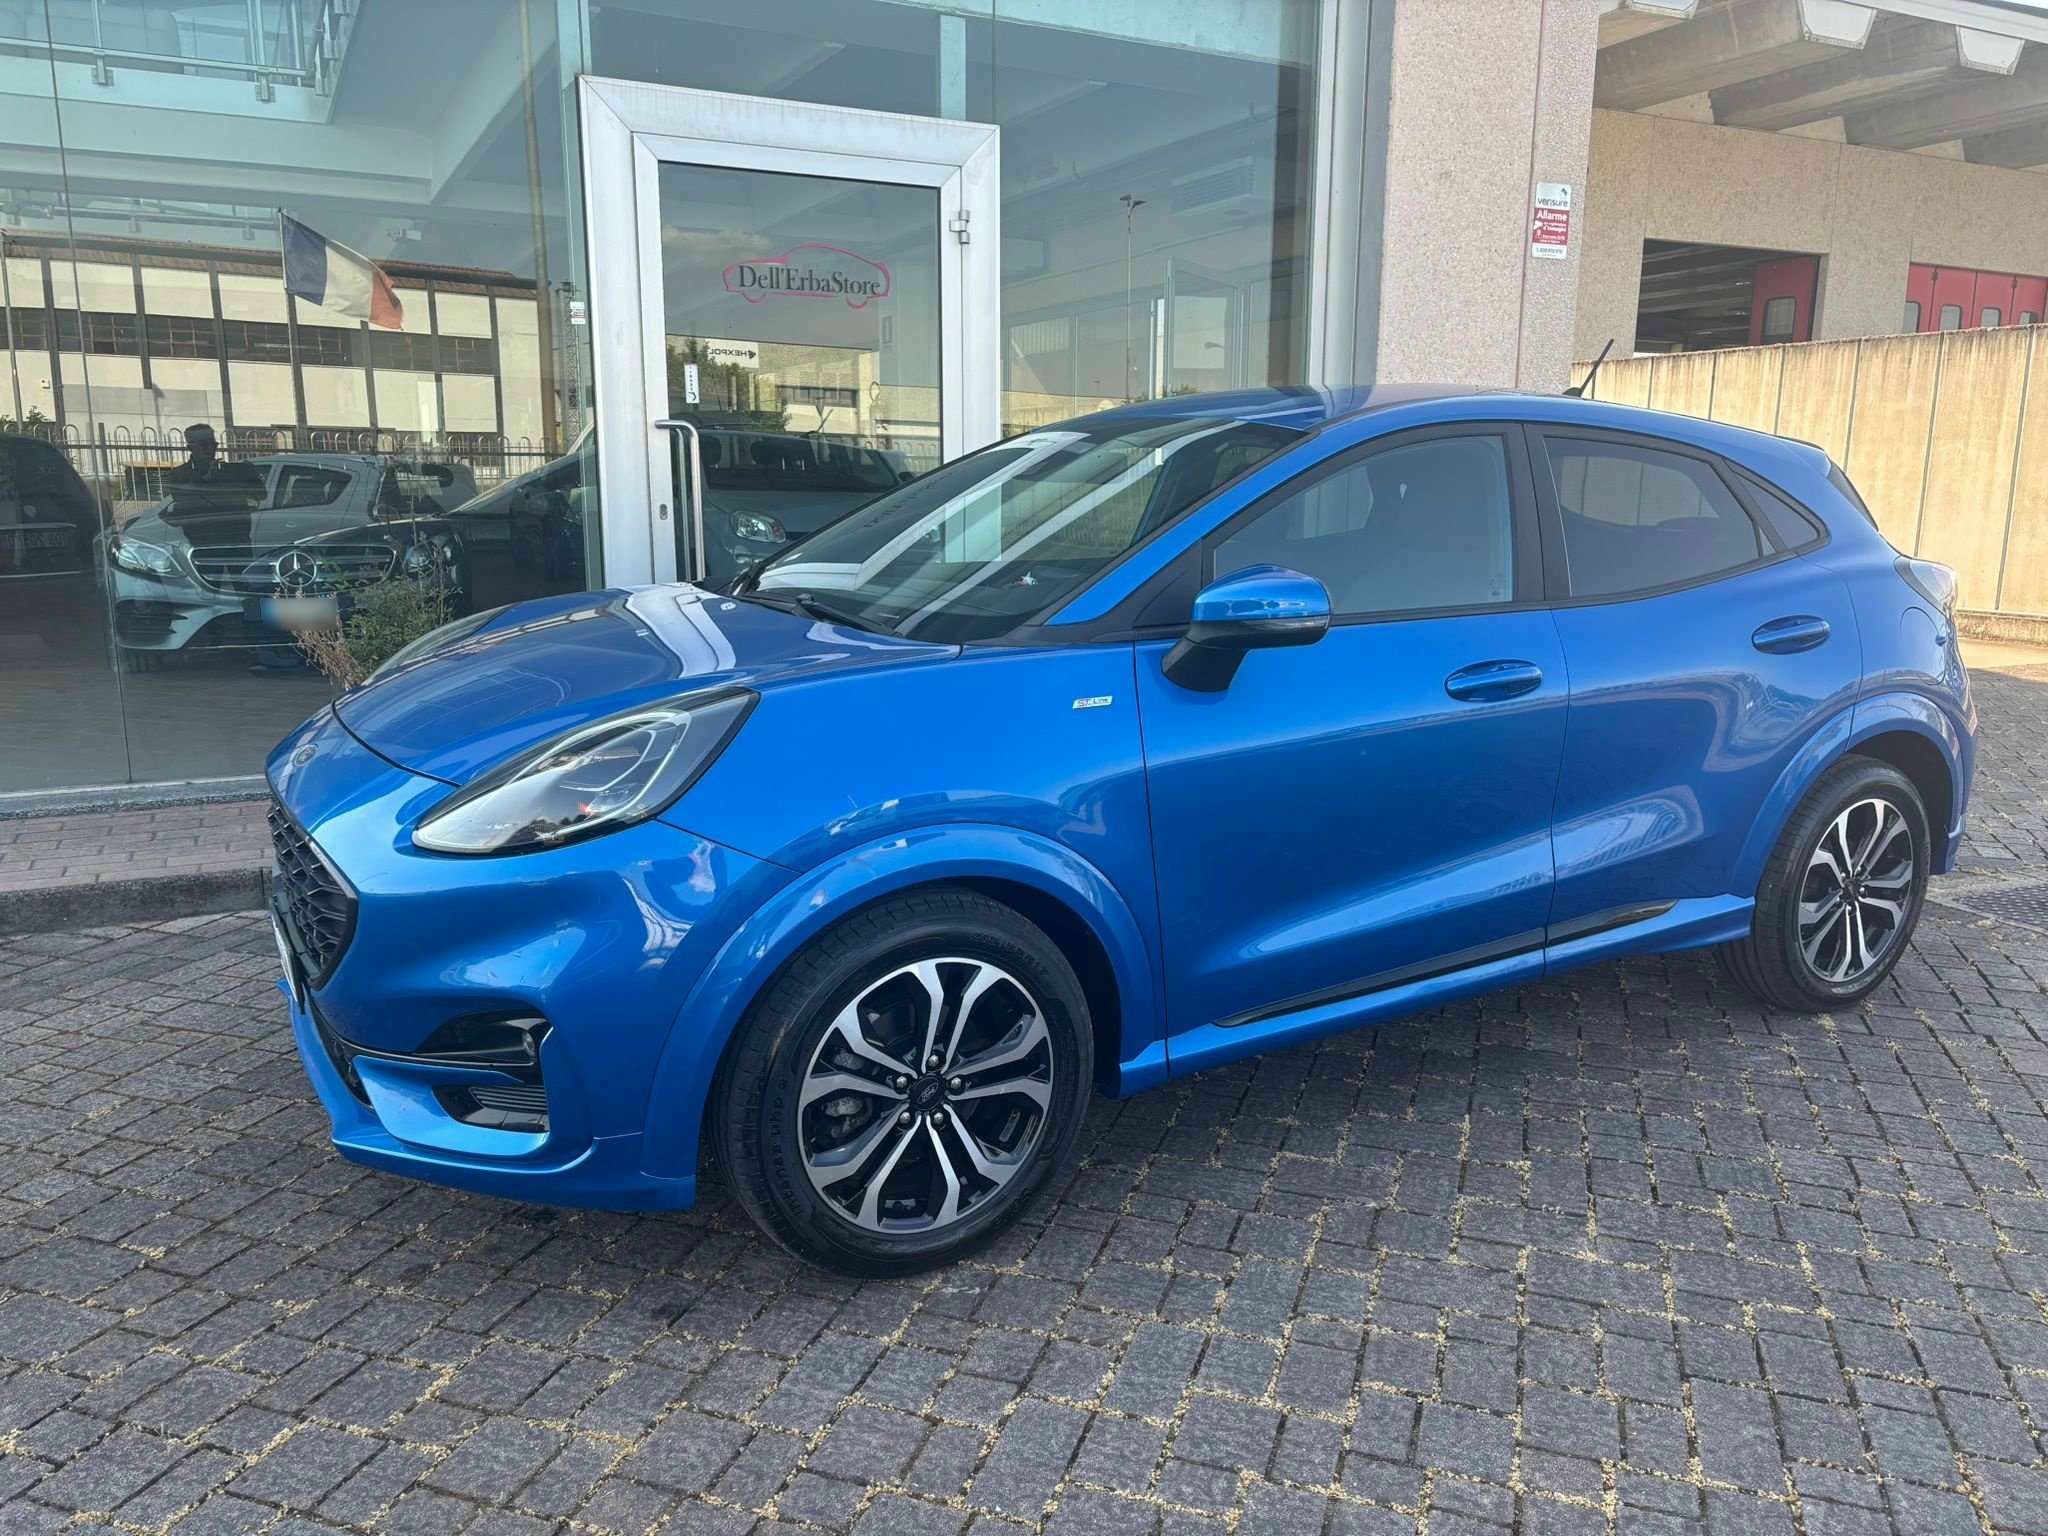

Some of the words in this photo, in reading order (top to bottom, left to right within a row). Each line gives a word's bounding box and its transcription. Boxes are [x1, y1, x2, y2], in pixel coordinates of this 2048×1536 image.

[1537, 198, 1569, 208] verisure
[1536, 210, 1568, 222] Allarme
[739, 265, 881, 296] Dell'ErbaStore
